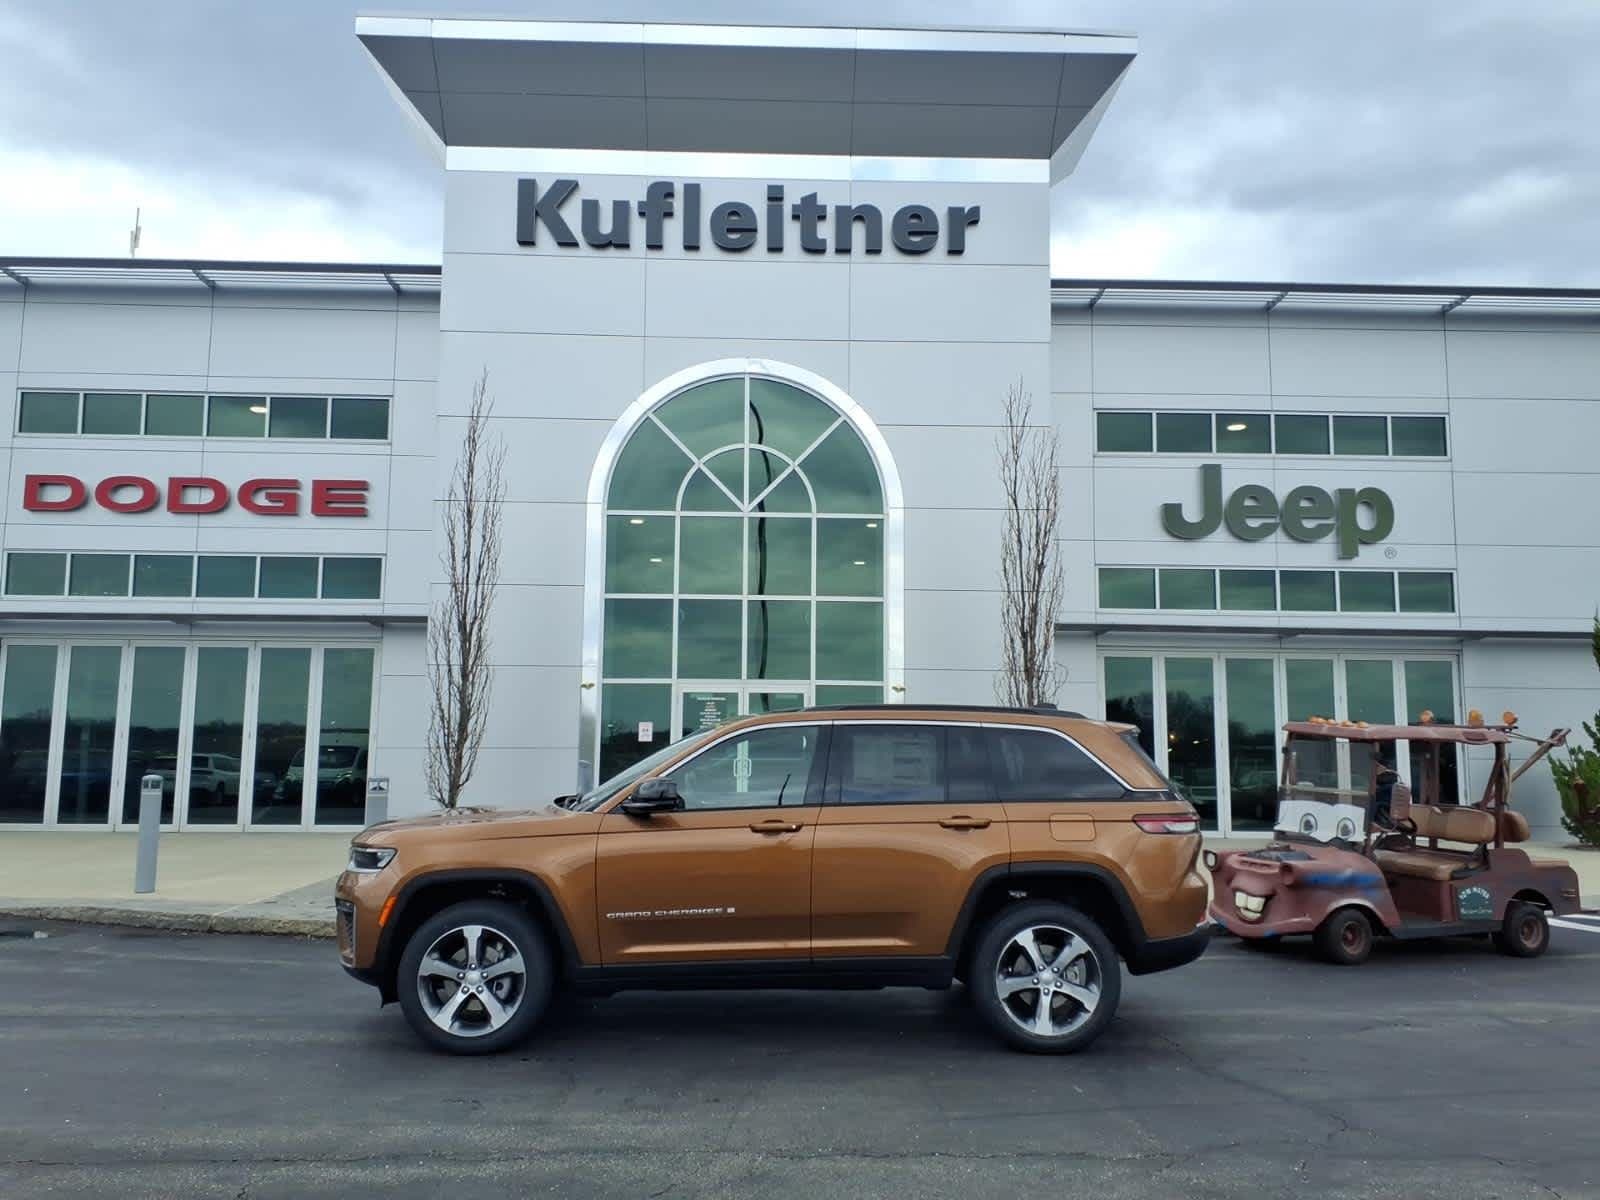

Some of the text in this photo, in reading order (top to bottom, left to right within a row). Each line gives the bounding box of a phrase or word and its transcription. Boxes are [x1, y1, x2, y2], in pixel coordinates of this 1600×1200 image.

[516, 178, 981, 255] Kufleitner
[24, 474, 370, 517] DODGE
[1161, 463, 1395, 560] Jeep
[606, 910, 652, 920] GRAND
[654, 907, 723, 917] CHEROKEE
